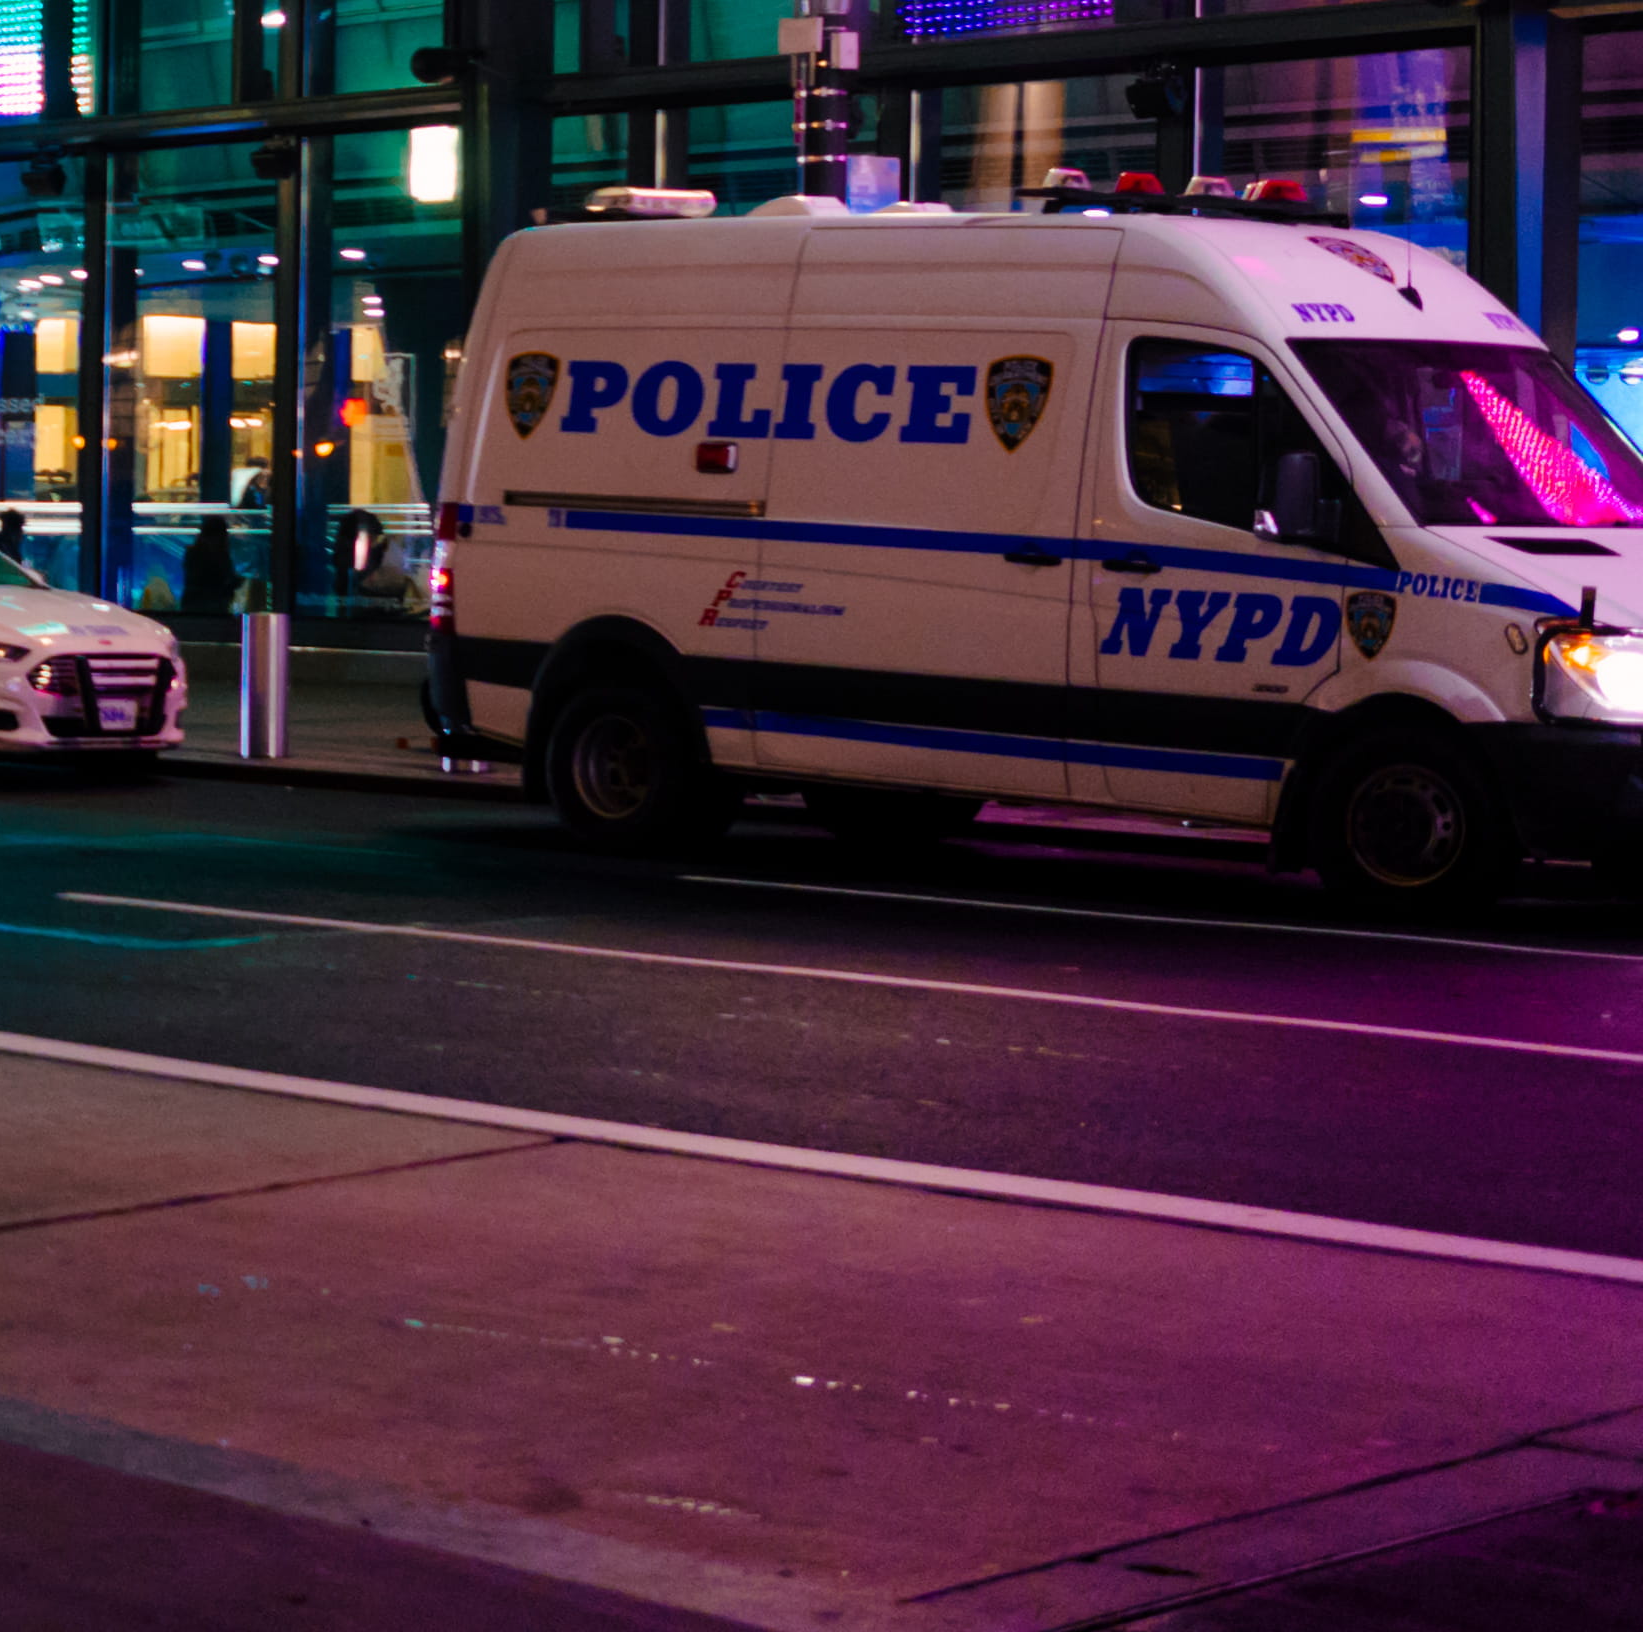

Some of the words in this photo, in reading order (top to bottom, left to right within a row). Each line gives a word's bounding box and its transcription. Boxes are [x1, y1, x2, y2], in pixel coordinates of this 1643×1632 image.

[1292, 303, 1356, 323] NYPD
[559, 360, 978, 445] POLICE
[1397, 571, 1480, 603] POLICE
[1099, 587, 1342, 668] NYPD
